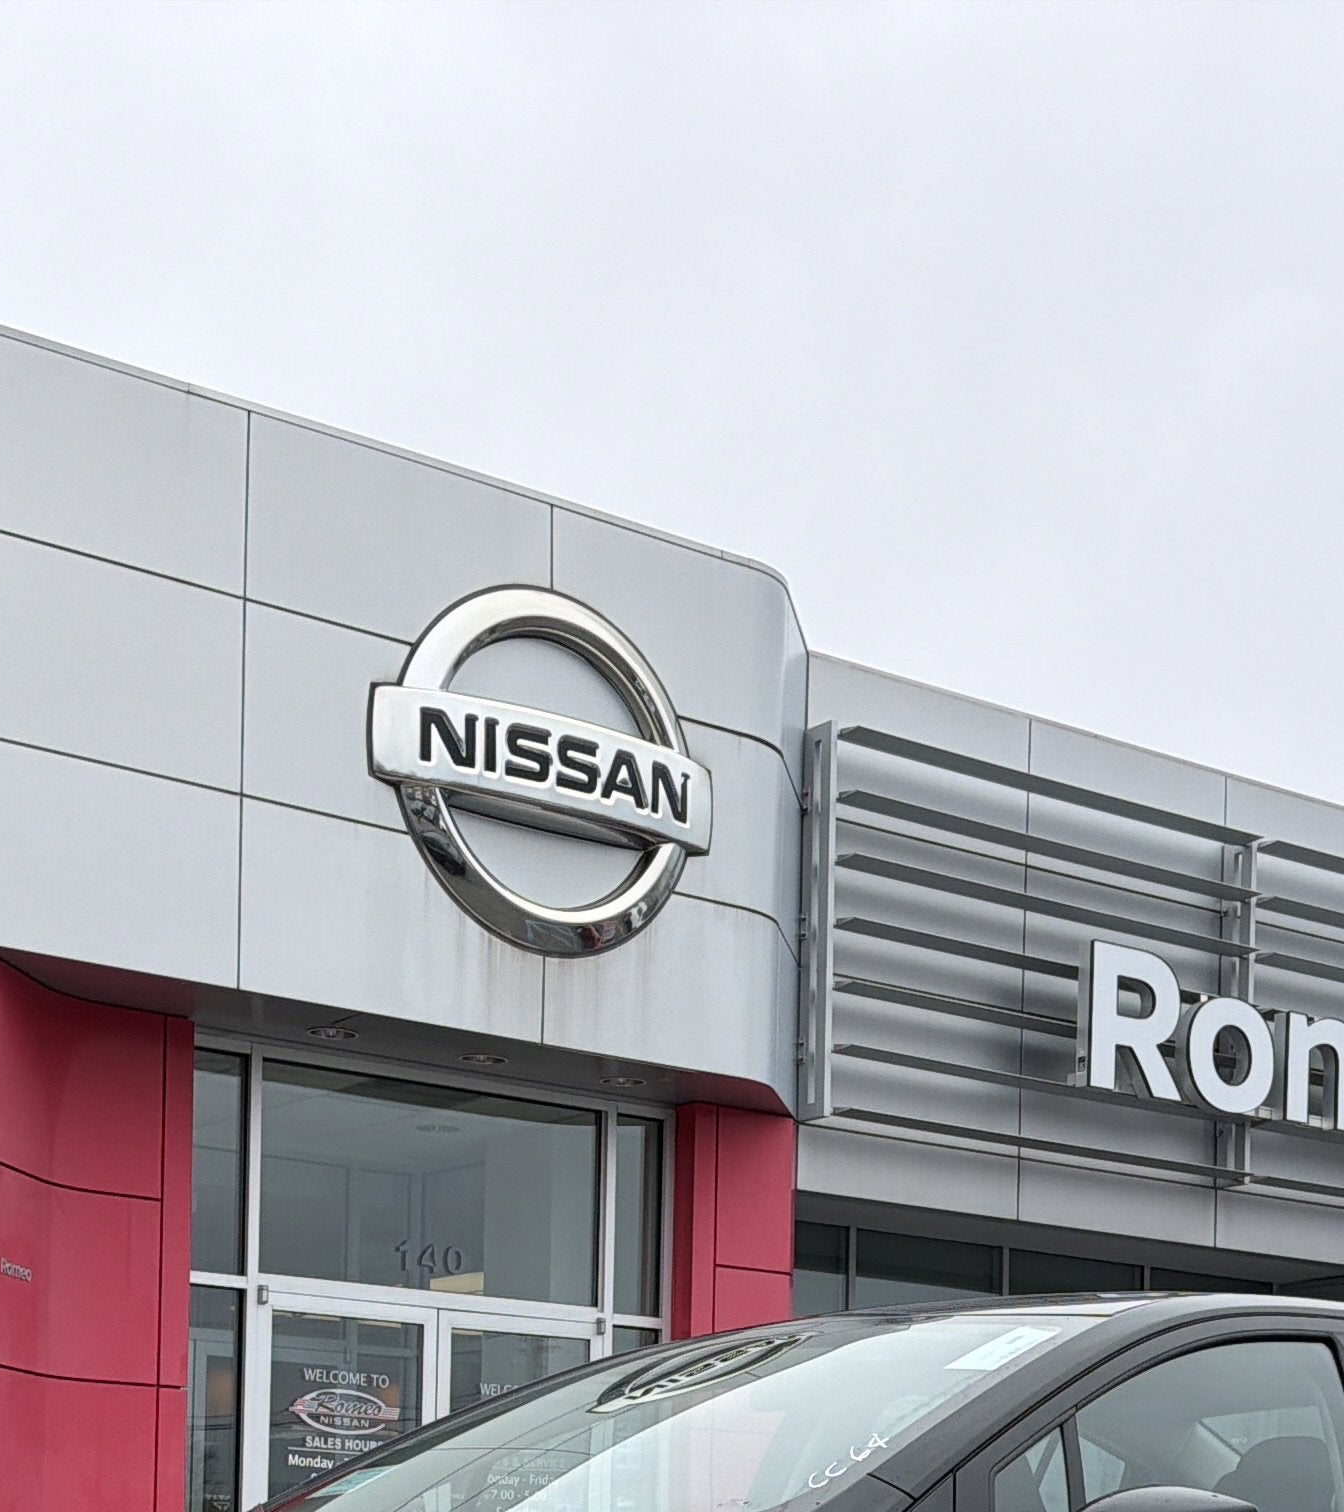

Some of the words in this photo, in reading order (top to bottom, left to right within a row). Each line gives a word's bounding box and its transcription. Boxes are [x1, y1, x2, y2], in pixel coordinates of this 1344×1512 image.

[418, 706, 691, 825] NISSAN
[395, 1240, 462, 1275] 140
[0, 1257, 32, 1282] Romeo
[303, 1367, 367, 1387] WELCOME
[371, 1373, 390, 1388] TO
[480, 1382, 518, 1397] WELC
[314, 1391, 383, 1417] Romeo
[319, 1416, 370, 1428] NISSAN
[305, 1435, 342, 1449] SALES
[288, 1453, 335, 1469] Monday
